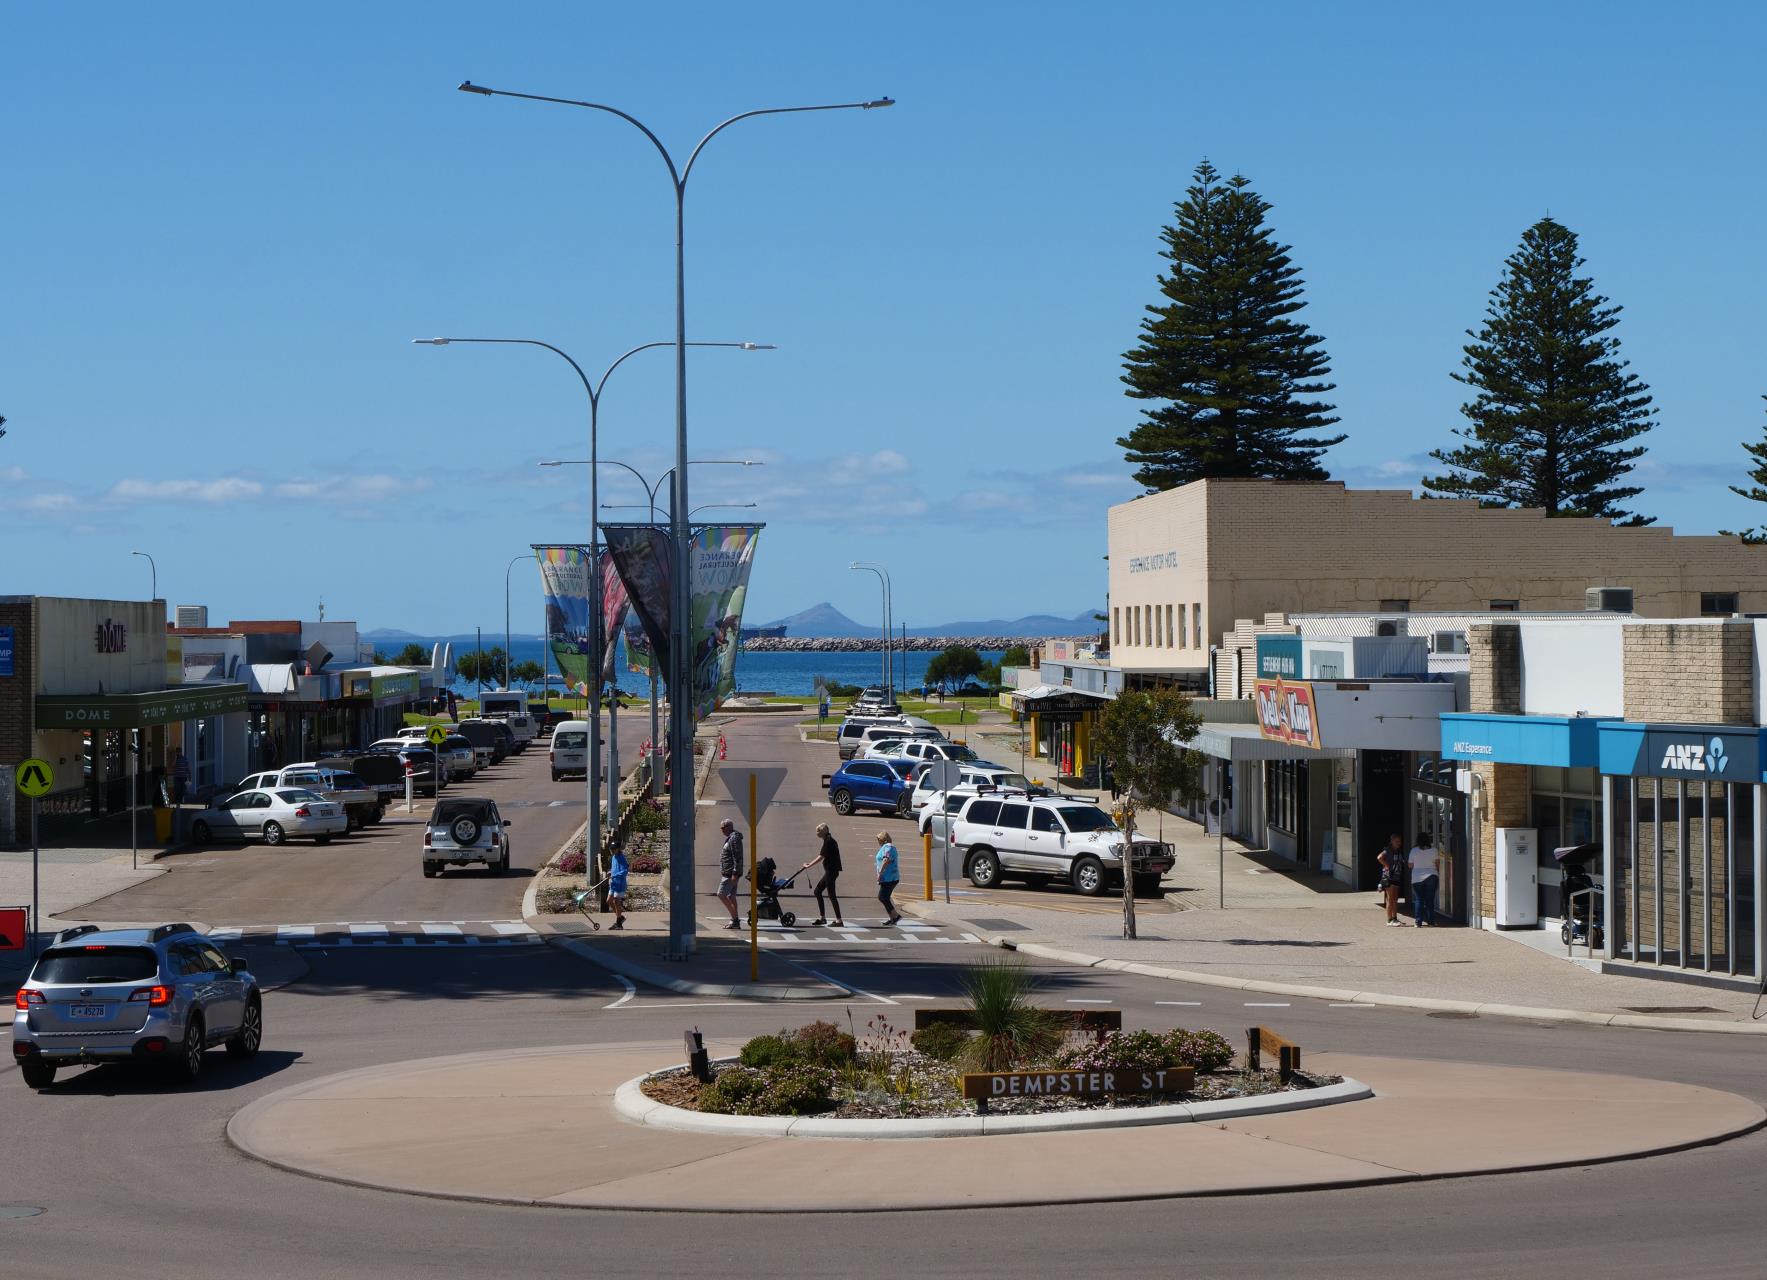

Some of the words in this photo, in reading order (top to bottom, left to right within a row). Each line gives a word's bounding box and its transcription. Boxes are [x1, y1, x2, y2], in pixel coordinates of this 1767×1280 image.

[545, 565, 582, 574] SPRANCE
[1130, 557, 1149, 573] ESPERANCE
[1164, 551, 1178, 569] HOTEL
[65, 708, 111, 720] DÔME
[1260, 688, 1280, 730] Deli
[1287, 690, 1312, 746] King
[1453, 742, 1465, 753] ANZ
[1465, 743, 1493, 756] Esperance
[1661, 744, 1705, 770] ANZ
[992, 1073, 1116, 1095] DEMPSTER
[1142, 1071, 1167, 1090] ST
